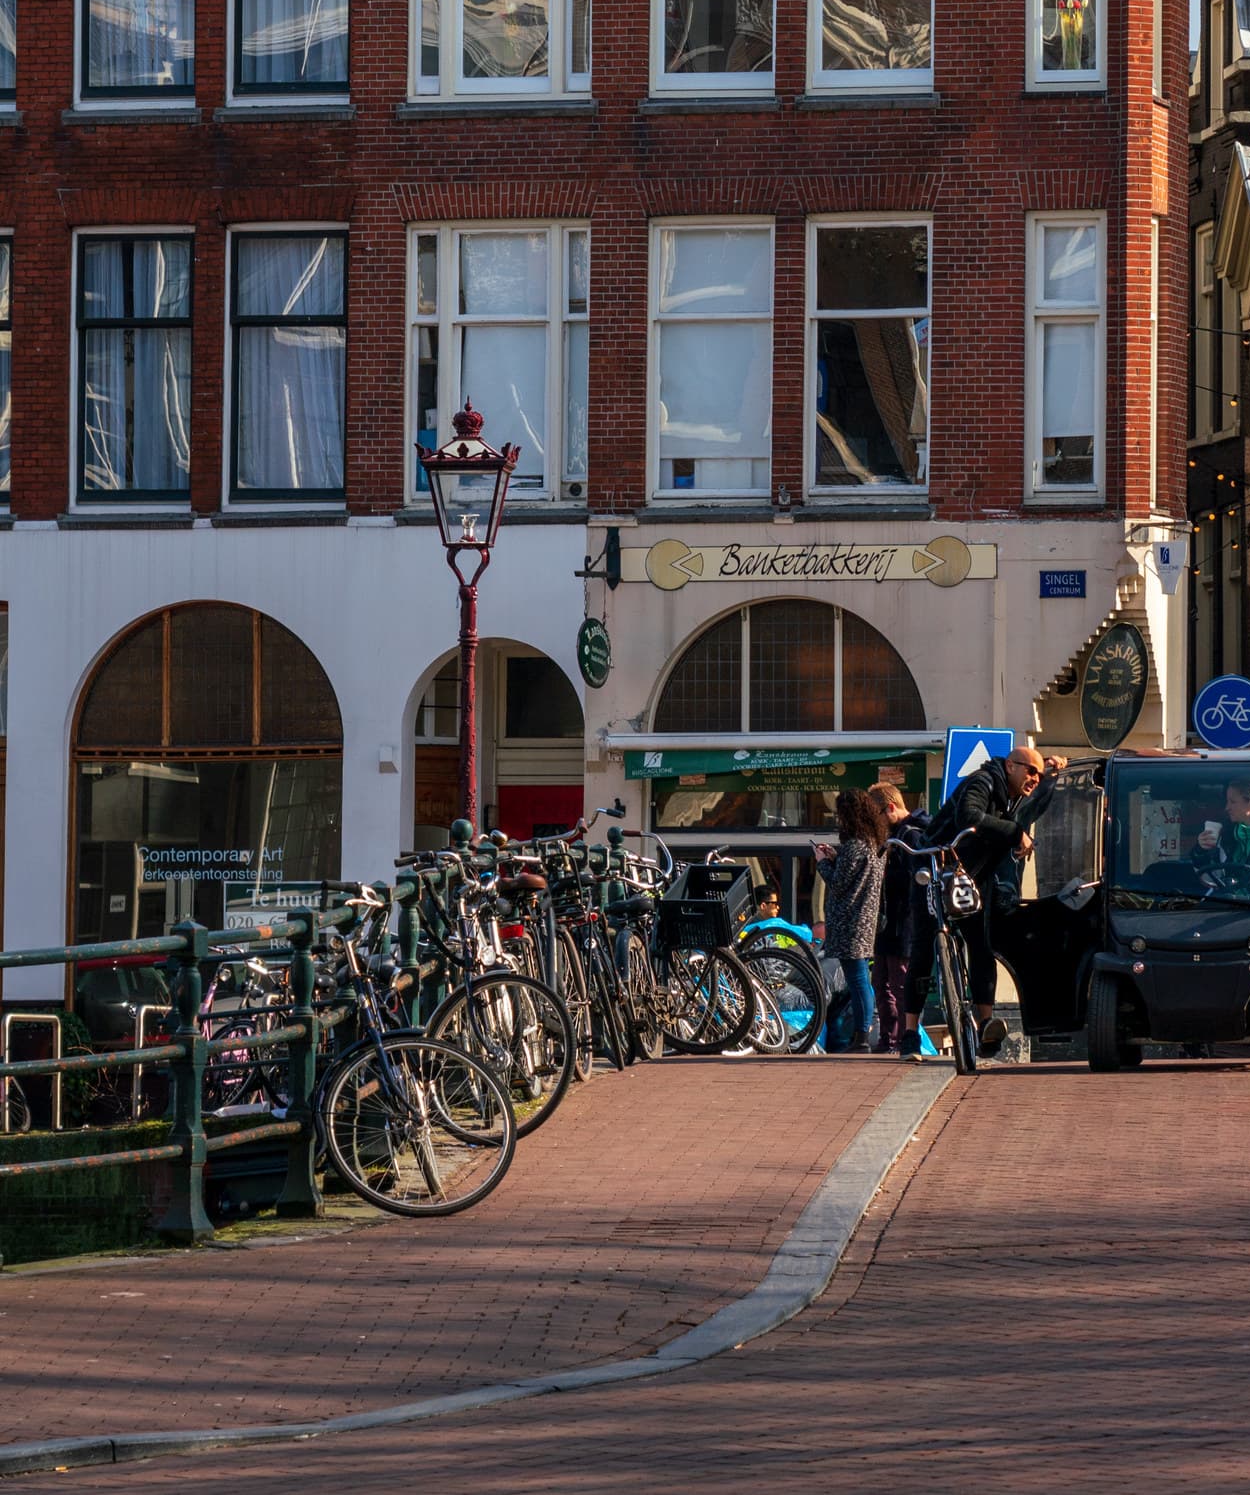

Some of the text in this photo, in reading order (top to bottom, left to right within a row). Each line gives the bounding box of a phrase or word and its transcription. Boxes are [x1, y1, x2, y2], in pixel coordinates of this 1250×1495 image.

[719, 543, 898, 583] Banketbakkerij
[1045, 574, 1080, 585] SINGEL
[1049, 586, 1081, 594] CENTRUM
[815, 784, 840, 792] CREAM
[138, 847, 284, 865] Contemporary Art
[247, 887, 322, 908] Te huur
